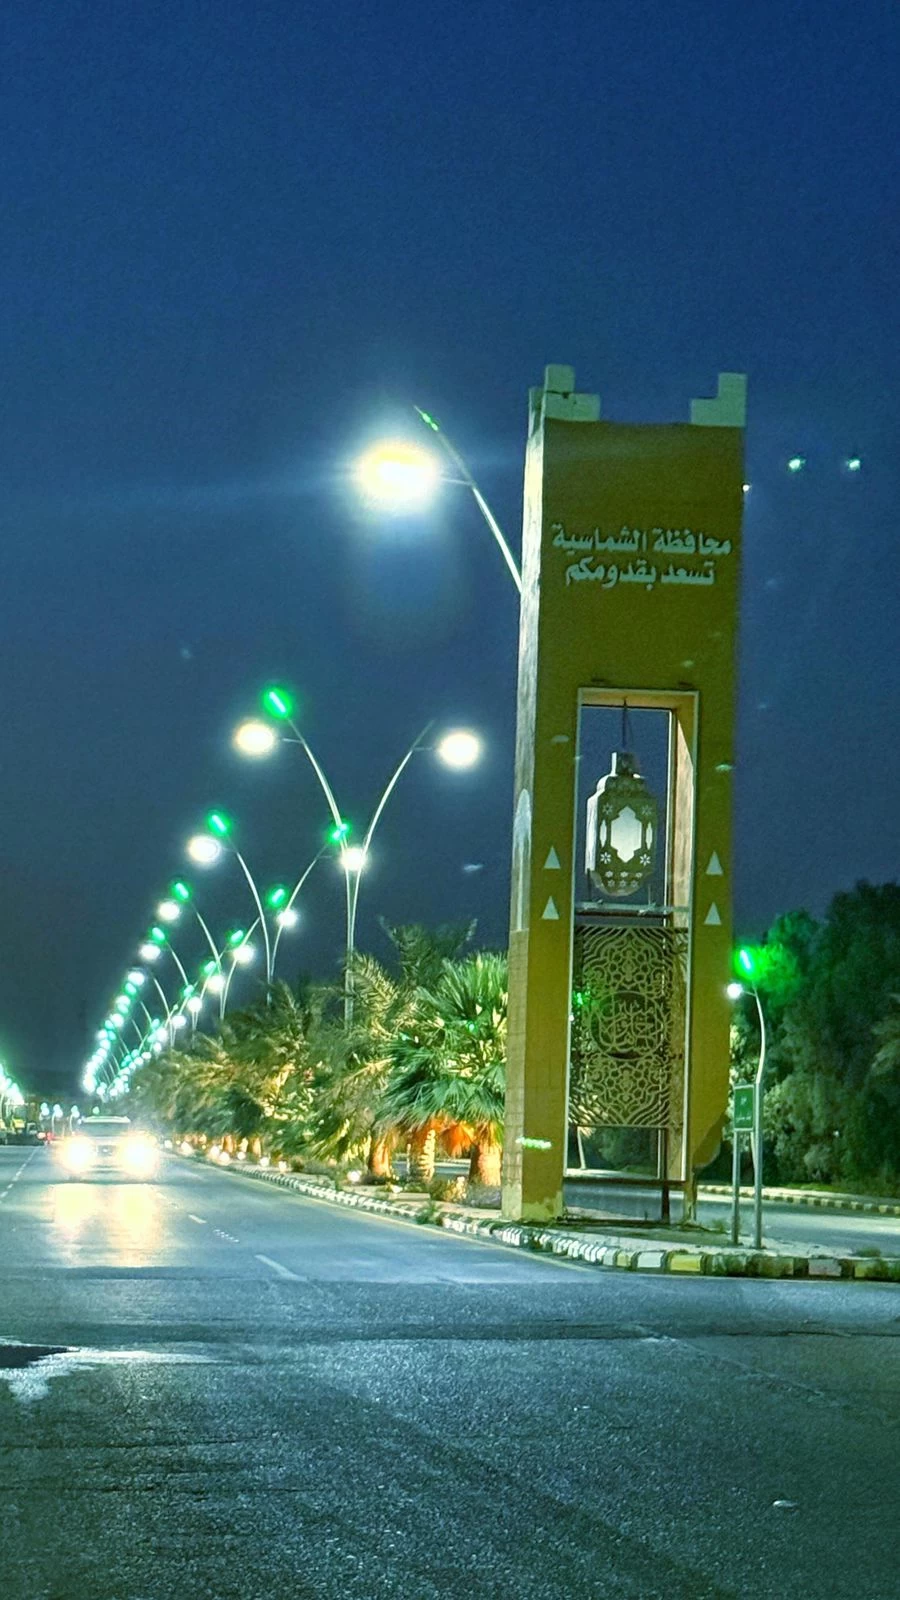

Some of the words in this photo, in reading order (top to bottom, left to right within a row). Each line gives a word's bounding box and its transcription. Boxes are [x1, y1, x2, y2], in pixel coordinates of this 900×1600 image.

[551, 523, 647, 556] الشماسية
[652, 527, 732, 555] محافظة
[565, 556, 657, 591] بقدومكم
[660, 561, 715, 585] تسعد
